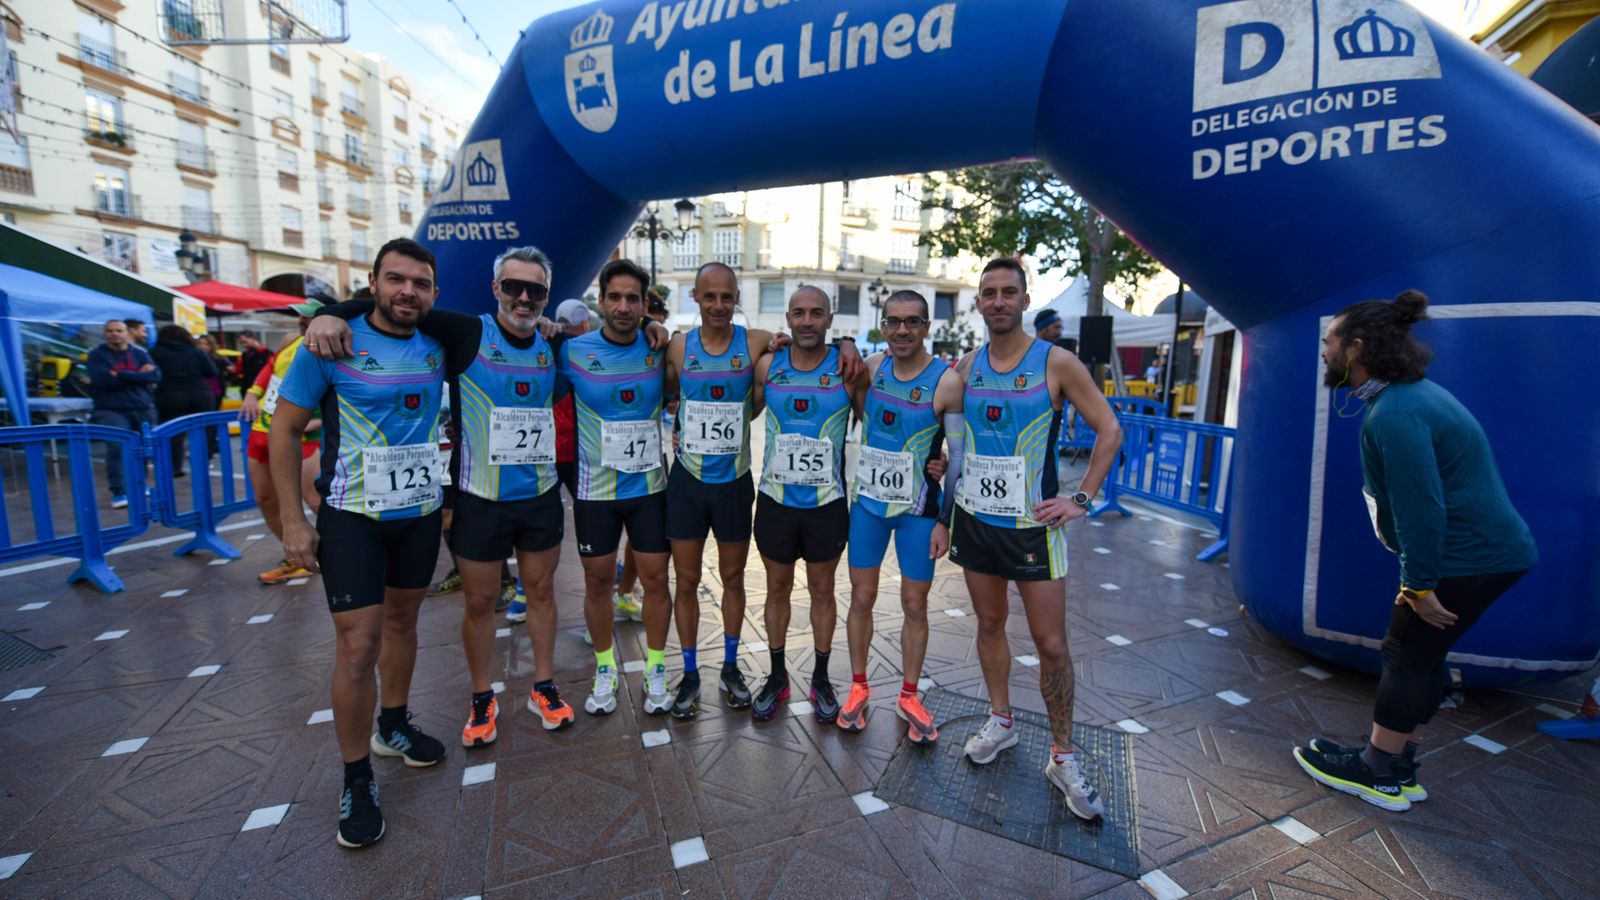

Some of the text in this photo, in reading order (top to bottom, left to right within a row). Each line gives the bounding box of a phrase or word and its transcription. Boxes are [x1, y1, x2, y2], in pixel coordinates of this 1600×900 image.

[663, 2, 957, 104] de La Línea
[1222, 21, 1285, 85] D
[1191, 87, 1397, 137] DELEGACIÓN DE
[1192, 114, 1448, 180] DEPORTES
[478, 204, 494, 215] DE
[427, 221, 520, 241] DEPORTES
[515, 429, 542, 449] 27
[699, 422, 735, 441] 156
[623, 440, 647, 458] 47
[788, 453, 824, 472] 155
[387, 465, 432, 491] 123
[870, 467, 904, 489] 160
[980, 477, 1007, 498] 88
[1373, 784, 1399, 793] HOKA
